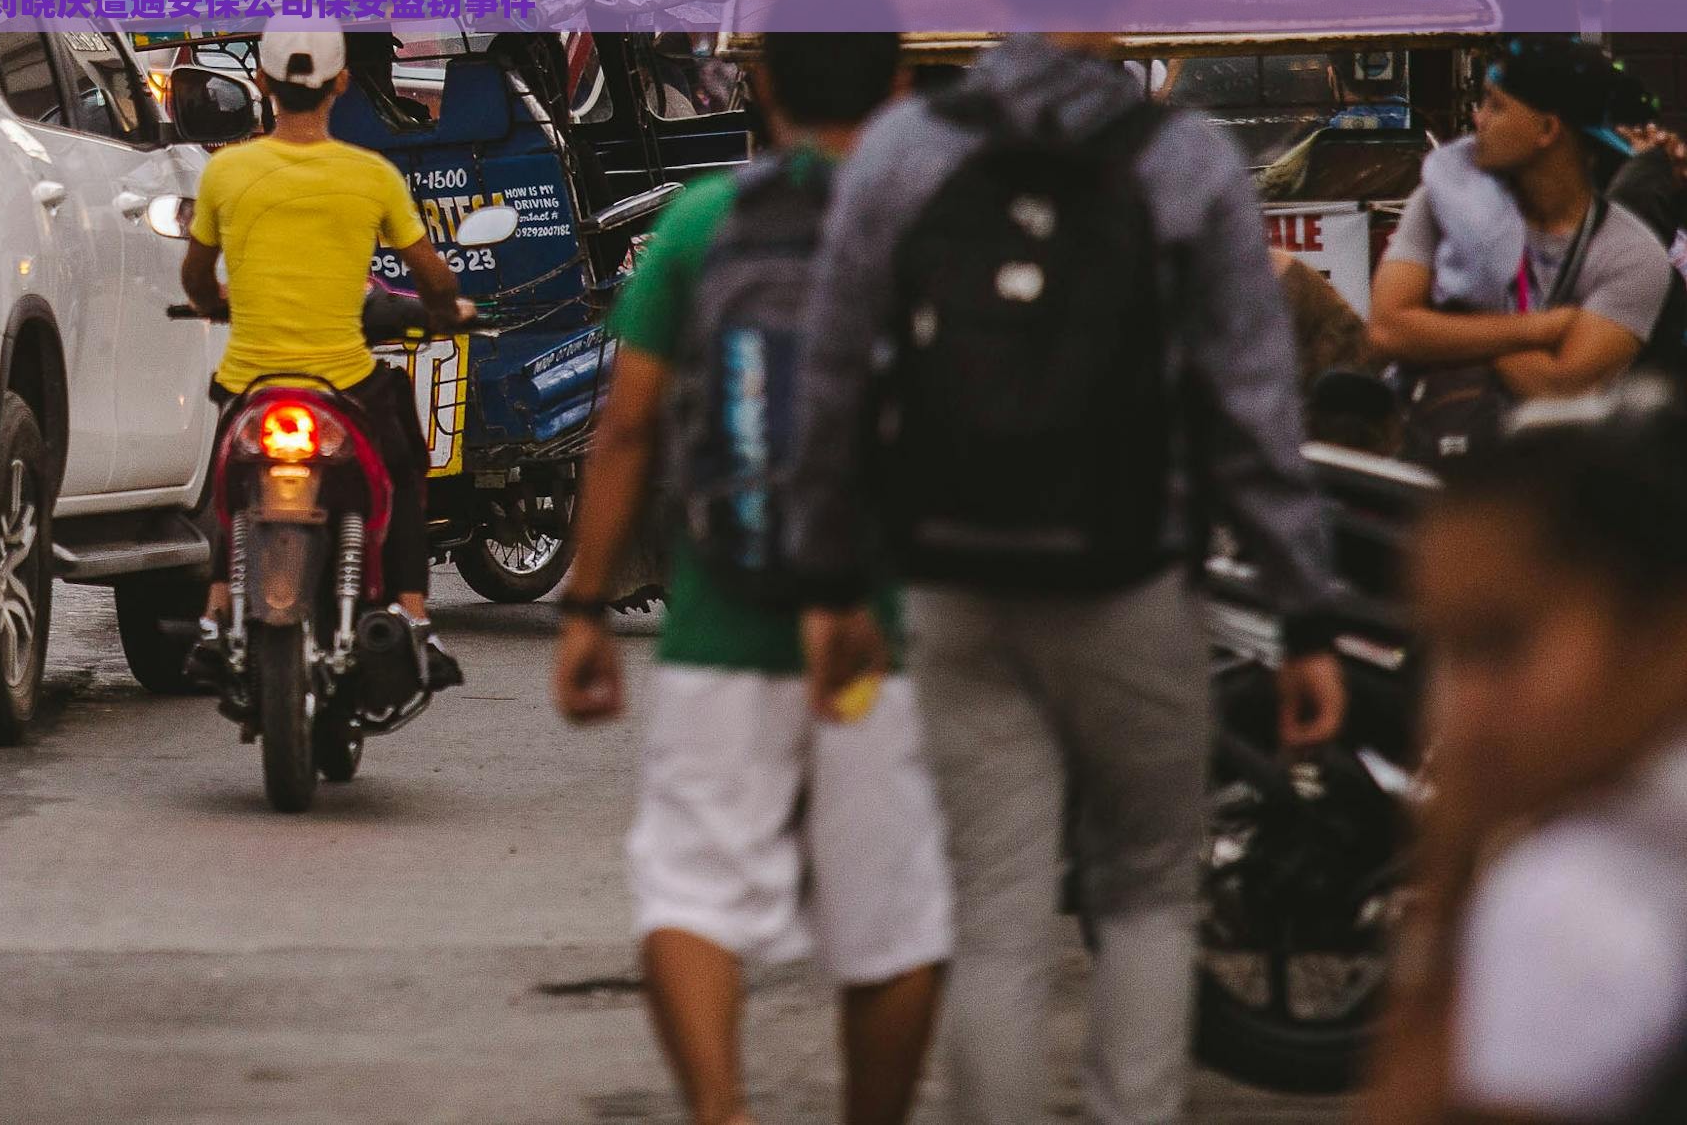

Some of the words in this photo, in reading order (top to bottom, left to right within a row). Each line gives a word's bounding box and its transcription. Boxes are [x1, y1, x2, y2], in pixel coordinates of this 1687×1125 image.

[504, 187, 527, 199] HOW
[528, 186, 538, 196] IS
[539, 185, 554, 195] MY
[514, 198, 559, 210] DRIVING
[466, 248, 496, 271] 23
